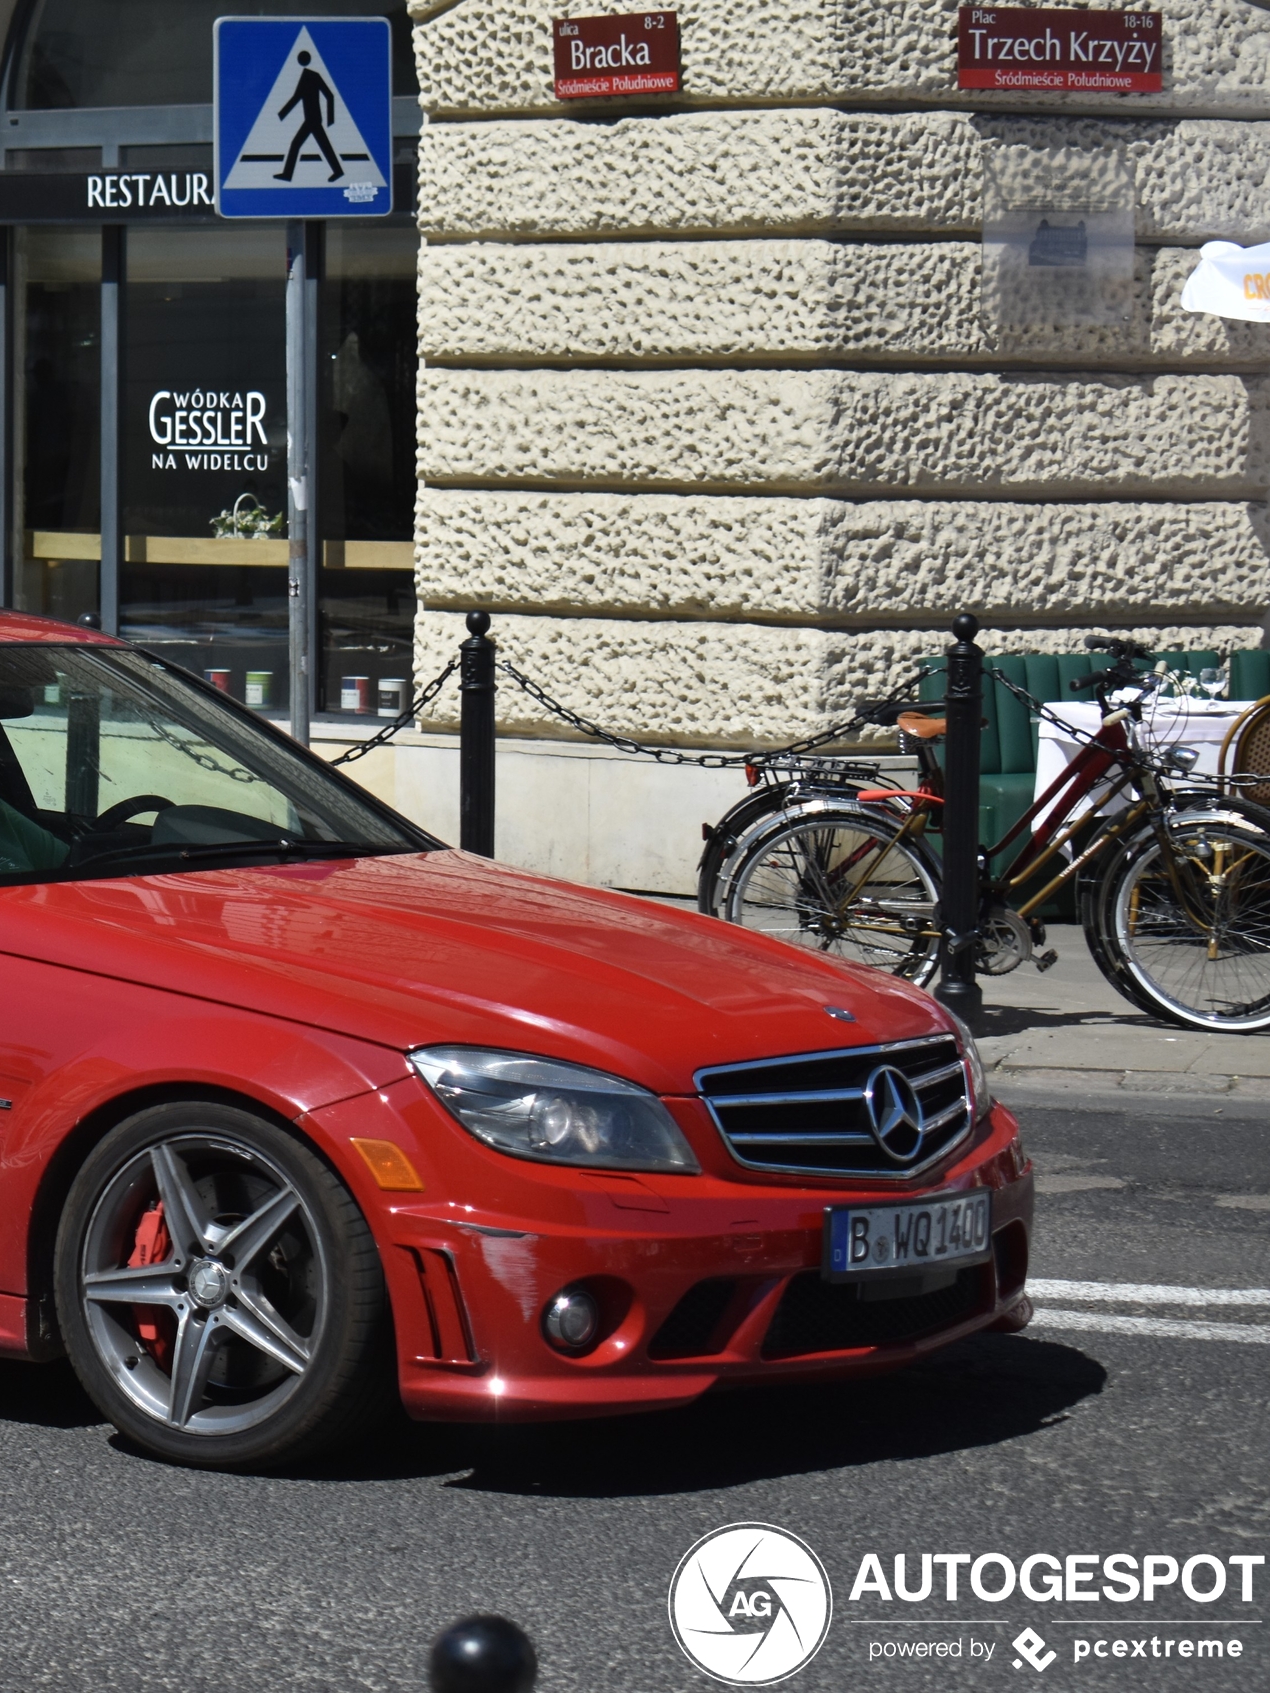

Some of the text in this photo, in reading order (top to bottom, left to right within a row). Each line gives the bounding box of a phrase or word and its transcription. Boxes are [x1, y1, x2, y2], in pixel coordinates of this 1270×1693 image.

[559, 15, 665, 36] ulica 8-2
[972, 10, 1154, 29] Plac 18-16
[570, 33, 651, 70] Bracka
[968, 28, 1157, 73] Trzech Krzyży
[558, 75, 674, 95] Śródmieście Południowe
[995, 69, 1132, 88] Śródmieście Południowe
[87, 173, 215, 208] RESTAUR
[173, 388, 244, 409] WÓDKA
[149, 391, 268, 445] GESSLER
[152, 453, 268, 471] NA WIDELCU
[850, 1216, 870, 1263] B
[834, 1249, 841, 1262] D
